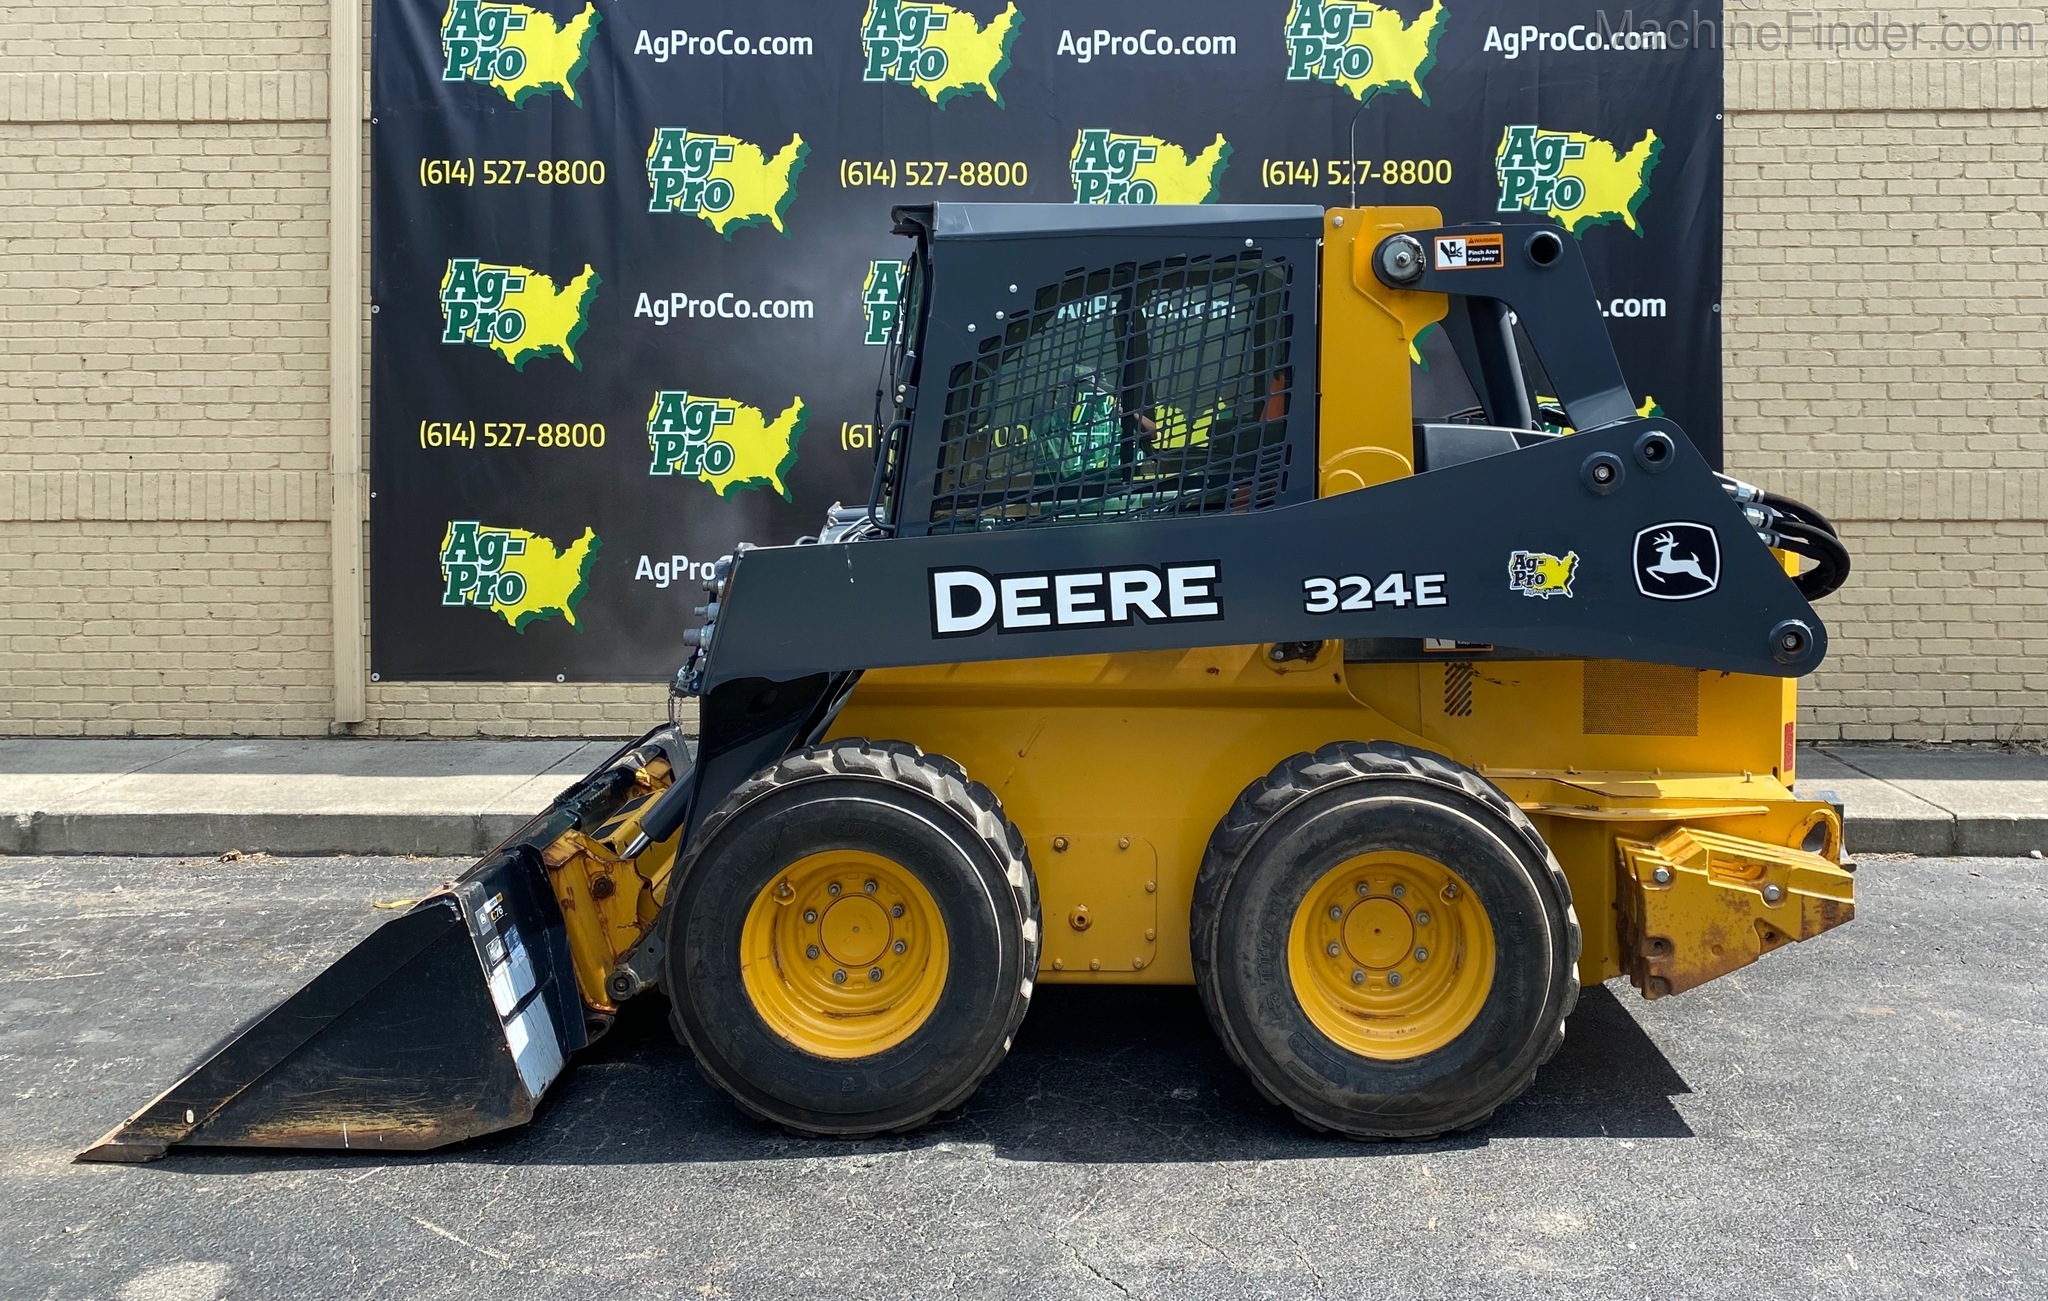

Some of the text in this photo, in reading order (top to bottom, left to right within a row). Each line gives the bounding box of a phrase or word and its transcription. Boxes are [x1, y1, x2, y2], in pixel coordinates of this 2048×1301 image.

[444, 0, 526, 47] Ag-
[866, 0, 948, 47] Ag-
[1289, 0, 1373, 47] Ag-
[1483, 25, 1666, 59] AgProCo.com
[442, 38, 526, 81] Pro
[634, 30, 813, 63] AgProCo.com
[863, 39, 948, 82] Pro
[1057, 30, 1236, 63] AgProCo.com
[1286, 38, 1373, 80] Pro
[650, 127, 734, 177] Ag-
[1072, 129, 1158, 181] Ag-
[1499, 125, 1586, 176] Ag-
[420, 159, 605, 186] (614) 527-8800
[648, 169, 734, 213] Pro
[841, 159, 1028, 188] (614) 527-8800
[1074, 170, 1157, 204] Pro
[1262, 158, 1452, 188] (614) 527-8800
[1497, 168, 1586, 212] Pro
[442, 258, 526, 309] Ag-
[441, 300, 526, 344] Pro
[634, 292, 814, 326] AgProCo.com
[1596, 298, 1666, 317] .com
[420, 421, 606, 450] (614) 527-8800
[650, 391, 735, 441] Ag-
[649, 432, 735, 476] Pro
[443, 521, 526, 572] Ag-
[1512, 553, 1546, 573] Ag-
[442, 563, 527, 606] Pro
[933, 564, 1219, 633] DEERE
[1303, 573, 1448, 613] 324E
[1513, 570, 1546, 587] Pro
